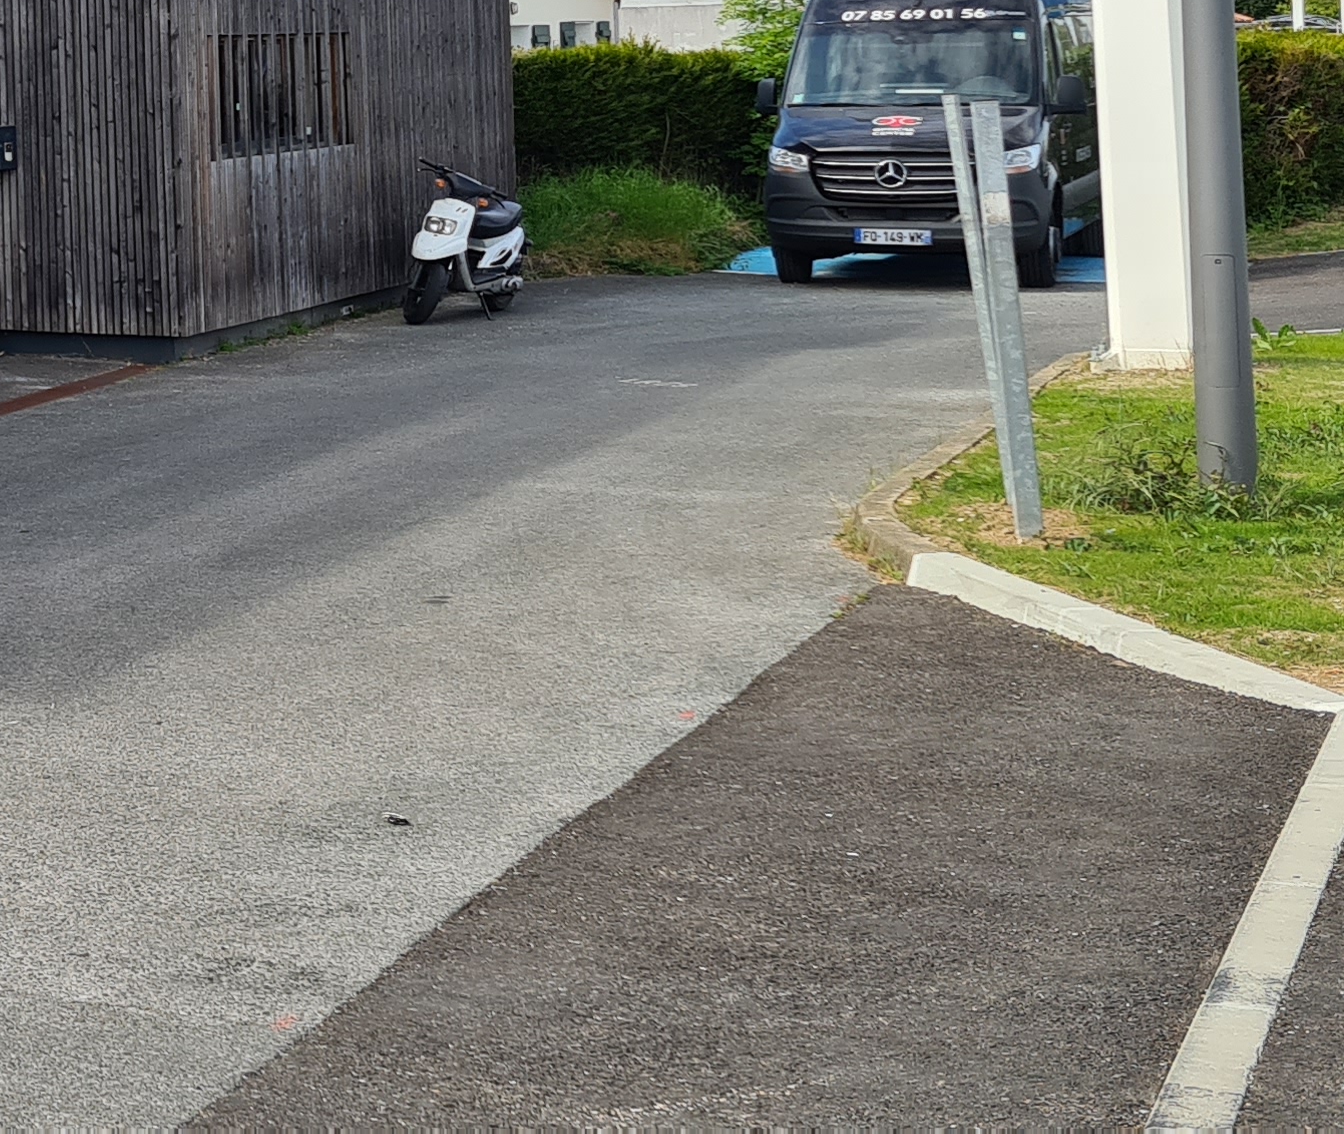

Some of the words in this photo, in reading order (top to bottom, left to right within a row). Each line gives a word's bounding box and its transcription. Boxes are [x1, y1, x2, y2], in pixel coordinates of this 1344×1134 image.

[841, 10, 868, 22] 07
[869, 9, 896, 21] 85
[899, 8, 926, 20] 69
[929, 8, 954, 20] 01
[960, 7, 987, 19] 56
